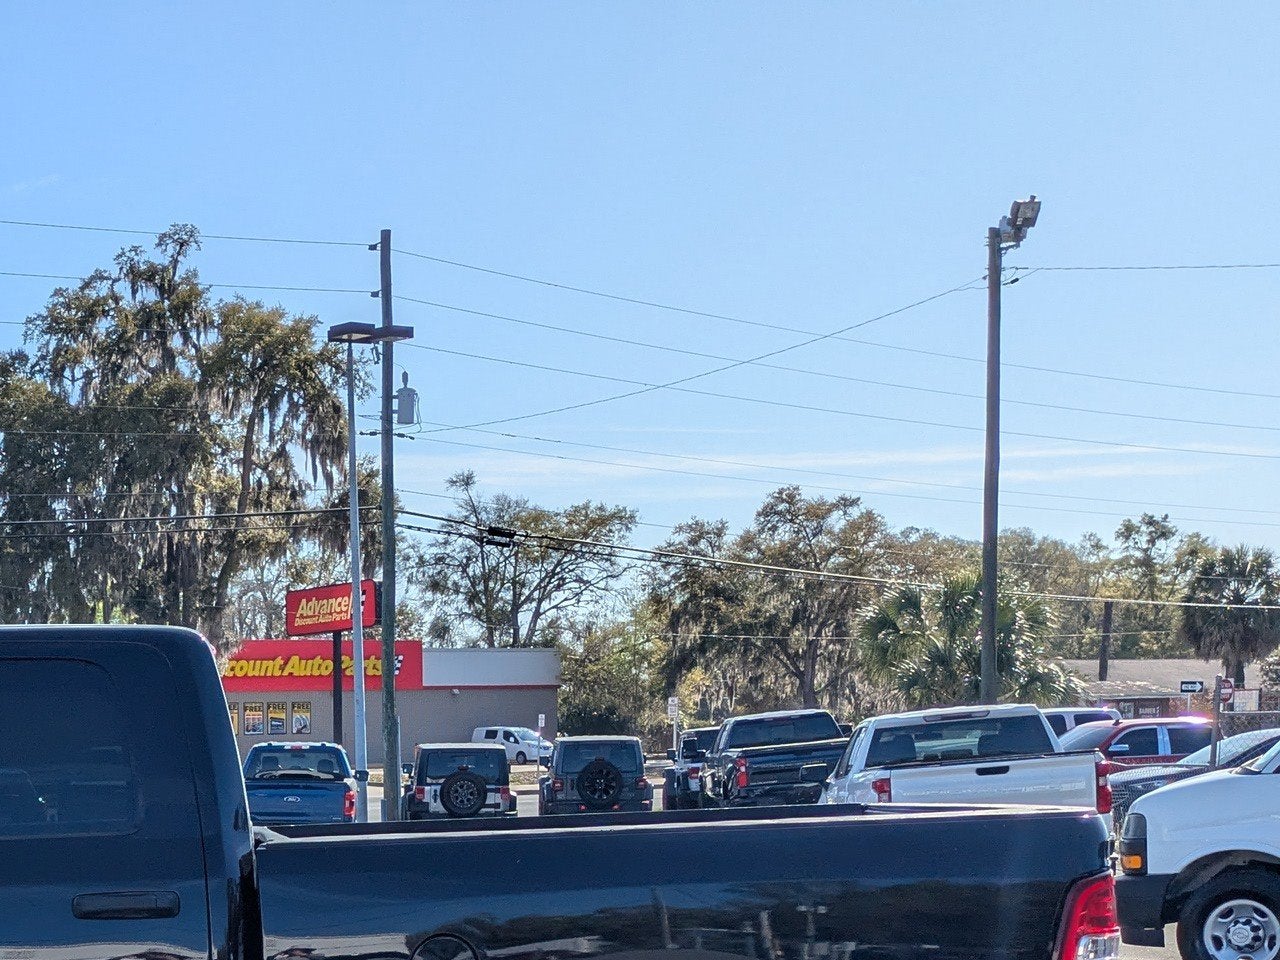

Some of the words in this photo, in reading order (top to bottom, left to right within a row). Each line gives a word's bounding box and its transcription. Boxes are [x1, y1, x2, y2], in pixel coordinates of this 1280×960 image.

[296, 596, 349, 617] Advance
[294, 616, 319, 626] Discount
[319, 613, 332, 623] Auto
[332, 612, 348, 622] Parts
[222, 656, 285, 677] count
[281, 655, 334, 677] Auto
